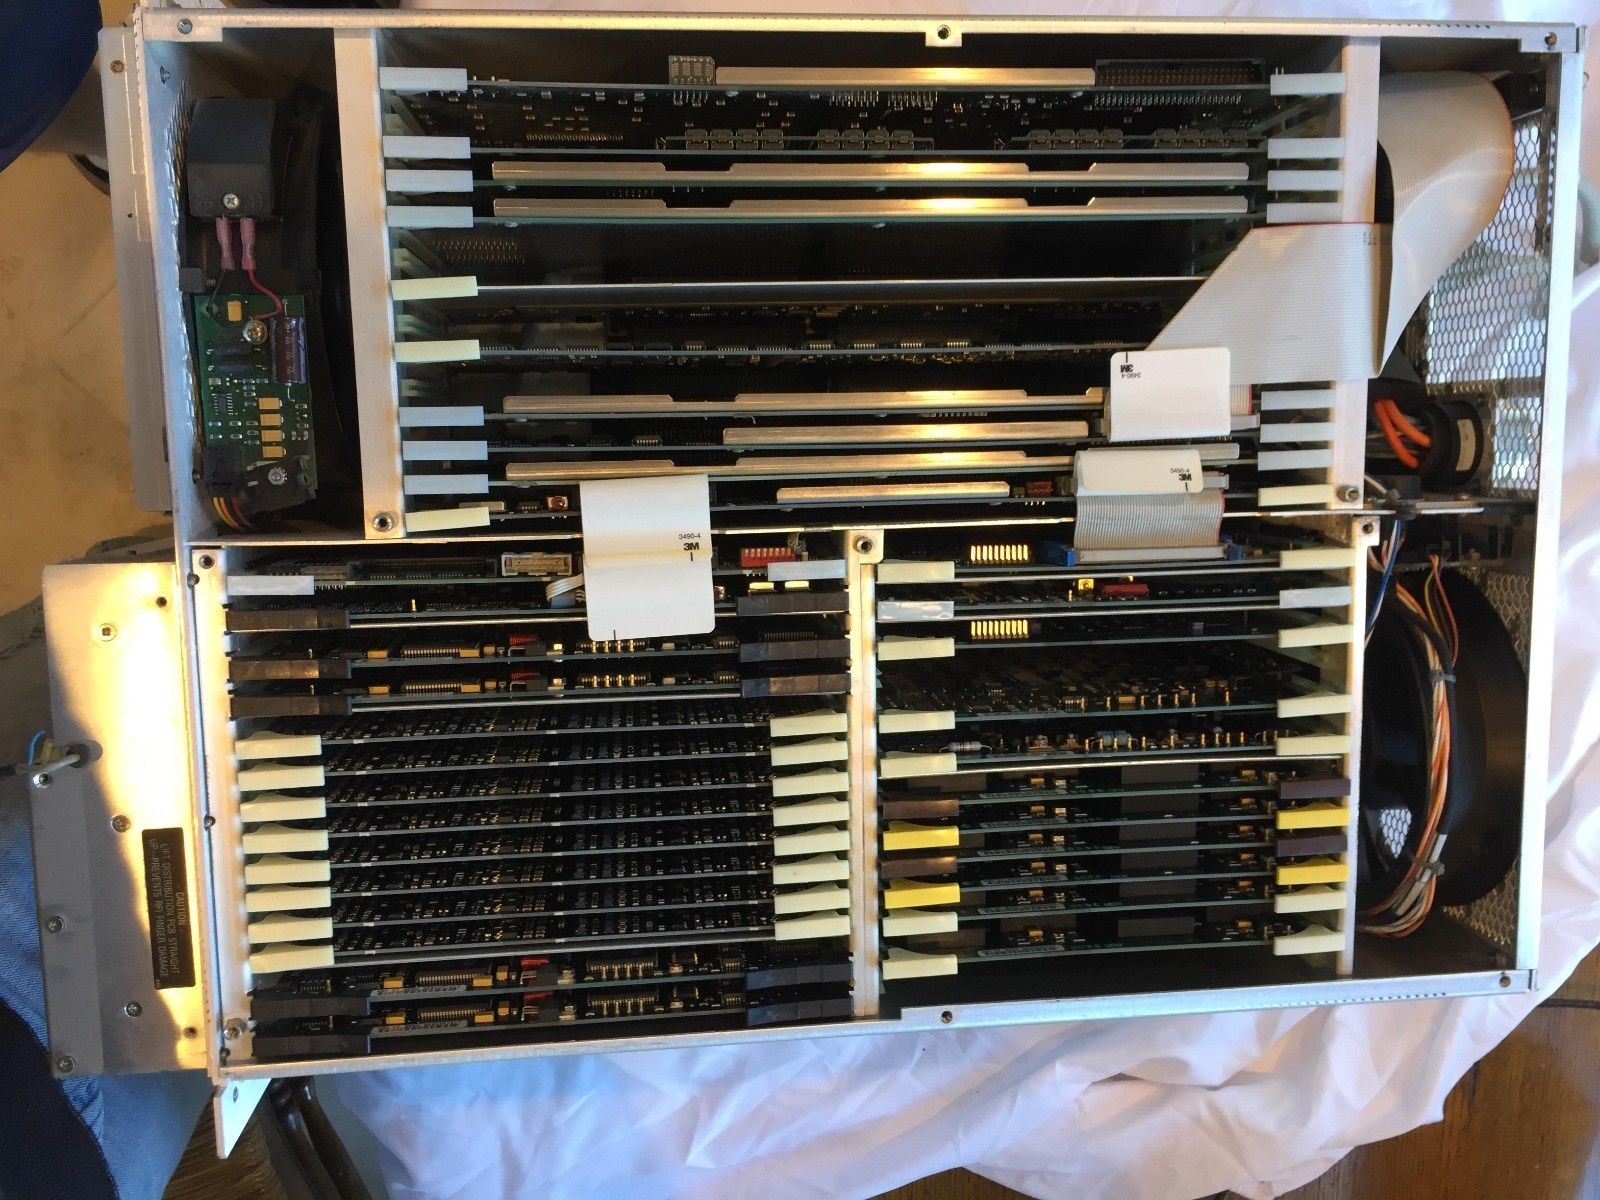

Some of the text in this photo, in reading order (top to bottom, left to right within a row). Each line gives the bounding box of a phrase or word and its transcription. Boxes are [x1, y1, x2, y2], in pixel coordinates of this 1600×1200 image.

[1120, 364, 1134, 373] 3M
[1178, 473, 1192, 481] 3M
[678, 532, 701, 540] 3490-4
[683, 542, 700, 551] 3M
[160, 843, 180, 974] LIFT DISTRIBUTION PCB STRAIGHT
[175, 891, 187, 926] CAUTION
[155, 915, 166, 944] FINGER
[158, 946, 169, 977] DAMAGE
